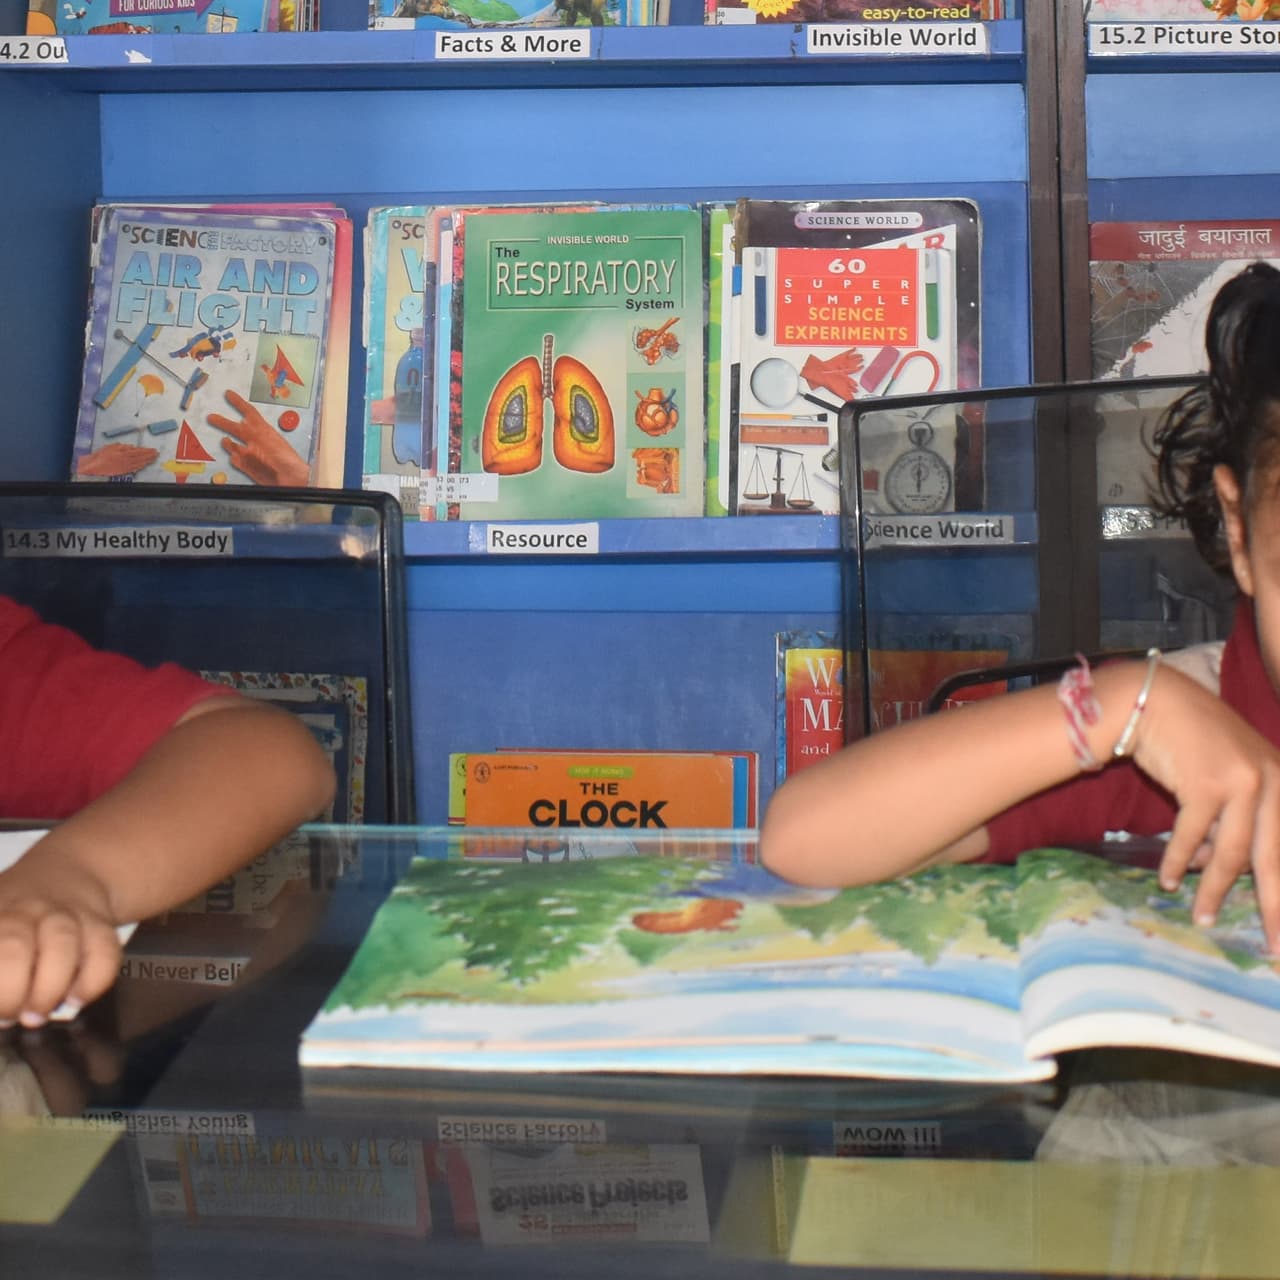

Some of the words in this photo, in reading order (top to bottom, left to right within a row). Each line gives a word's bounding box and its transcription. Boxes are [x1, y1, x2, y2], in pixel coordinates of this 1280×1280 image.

[862, 4, 971, 21] easy-to-read
[441, 35, 494, 53] Facts
[500, 35, 518, 53] &
[524, 35, 582, 53] More
[812, 28, 902, 47] Invisible
[909, 27, 977, 47] World
[1099, 26, 1147, 45] 15.2
[1153, 26, 1233, 46] Picture
[36, 40, 66, 59] Ou
[807, 216, 860, 225] SCIENCE
[863, 216, 909, 225] WORLD
[547, 234, 593, 245] INVISIBLE
[595, 234, 630, 244] WORLD
[1138, 224, 1187, 252] जादुई
[1198, 228, 1272, 246] बयाजाल
[495, 246, 520, 258] The
[120, 251, 203, 290] AIR
[217, 257, 320, 296] AND
[828, 258, 866, 274] 60
[495, 259, 677, 297] RESPIRATORY
[784, 278, 910, 289] SUPER
[625, 298, 675, 311] System
[784, 294, 910, 305] SIMPLE
[116, 287, 317, 336] FLIGHT
[808, 307, 885, 322] SCIENCE
[784, 326, 909, 341] EXPERIMENTS
[7, 532, 50, 550] 14.3
[56, 532, 88, 554] My
[93, 531, 170, 555] Healthy
[176, 531, 228, 554] Body
[490, 529, 588, 549] Resource
[579, 782, 619, 795] THE
[527, 799, 669, 829] CLOCK
[139, 962, 199, 980] Never
